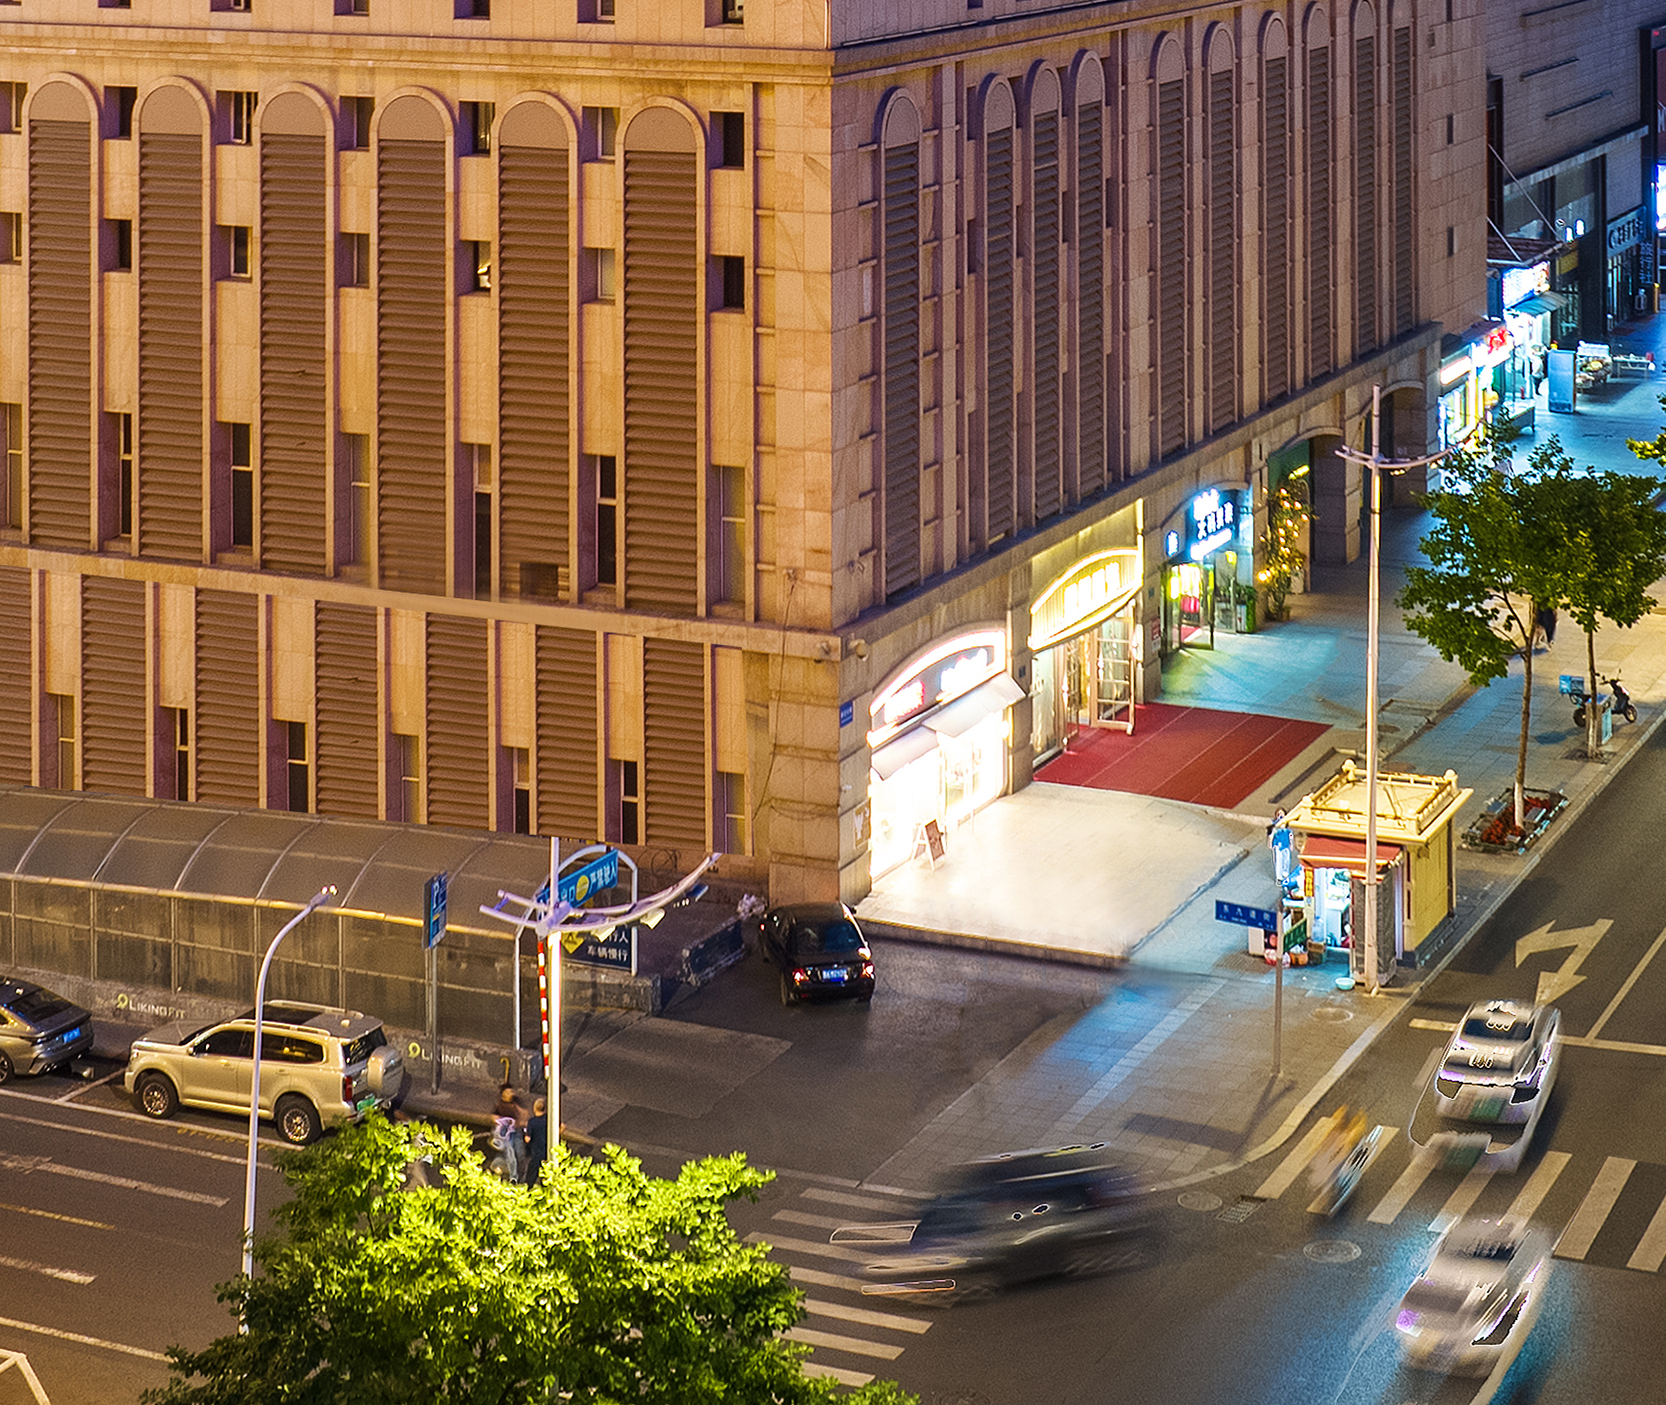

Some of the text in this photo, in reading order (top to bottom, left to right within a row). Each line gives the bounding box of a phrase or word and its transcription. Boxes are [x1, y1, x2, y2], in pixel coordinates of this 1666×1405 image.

[1639, 241, 1653, 285] 旅行社
[589, 861, 617, 894] 严禁驶入
[421, 1048, 482, 1069] LIINGFIT
